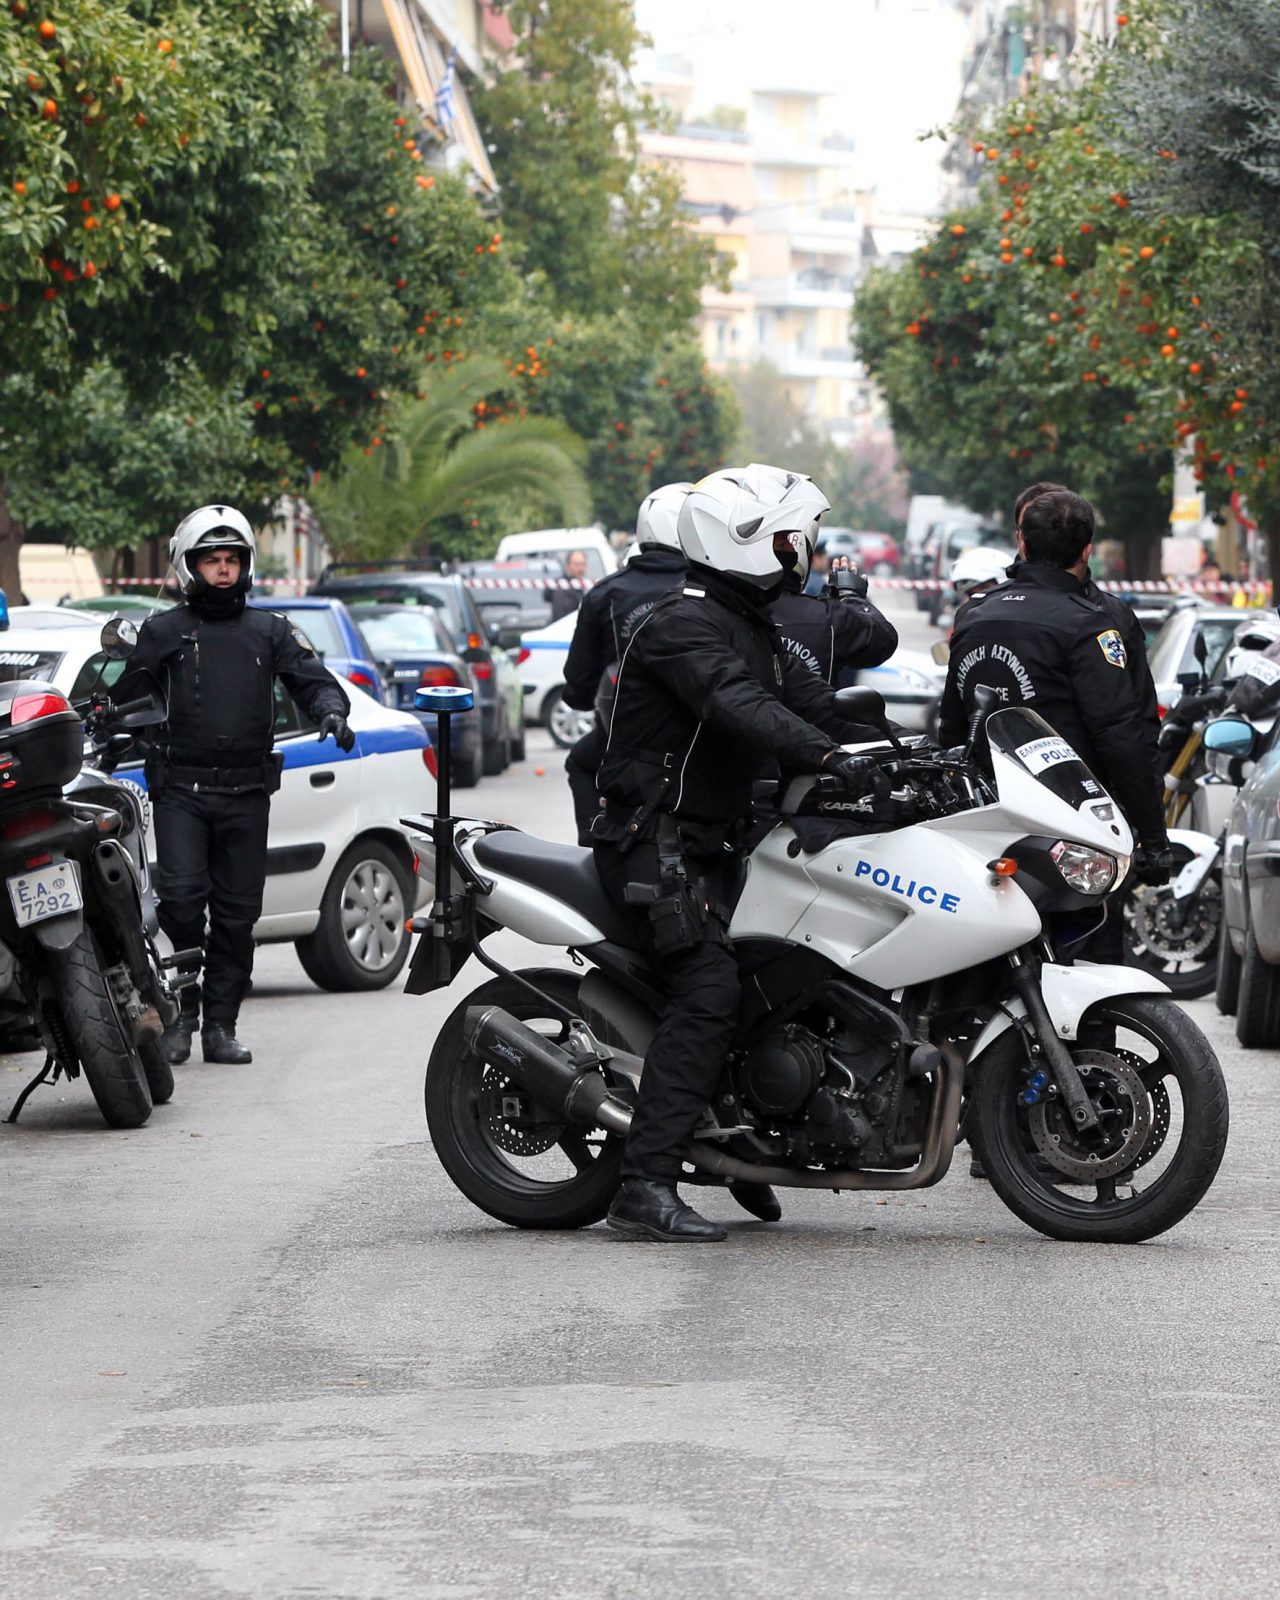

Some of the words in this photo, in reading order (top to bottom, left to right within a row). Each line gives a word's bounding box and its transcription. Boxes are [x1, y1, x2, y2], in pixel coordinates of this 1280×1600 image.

[991, 644, 1036, 701] ΑΣΤΥΝΟΜΙΑ
[822, 801, 874, 813] KAPPA
[21, 893, 73, 920] 7292
[854, 860, 961, 913] POLICE
